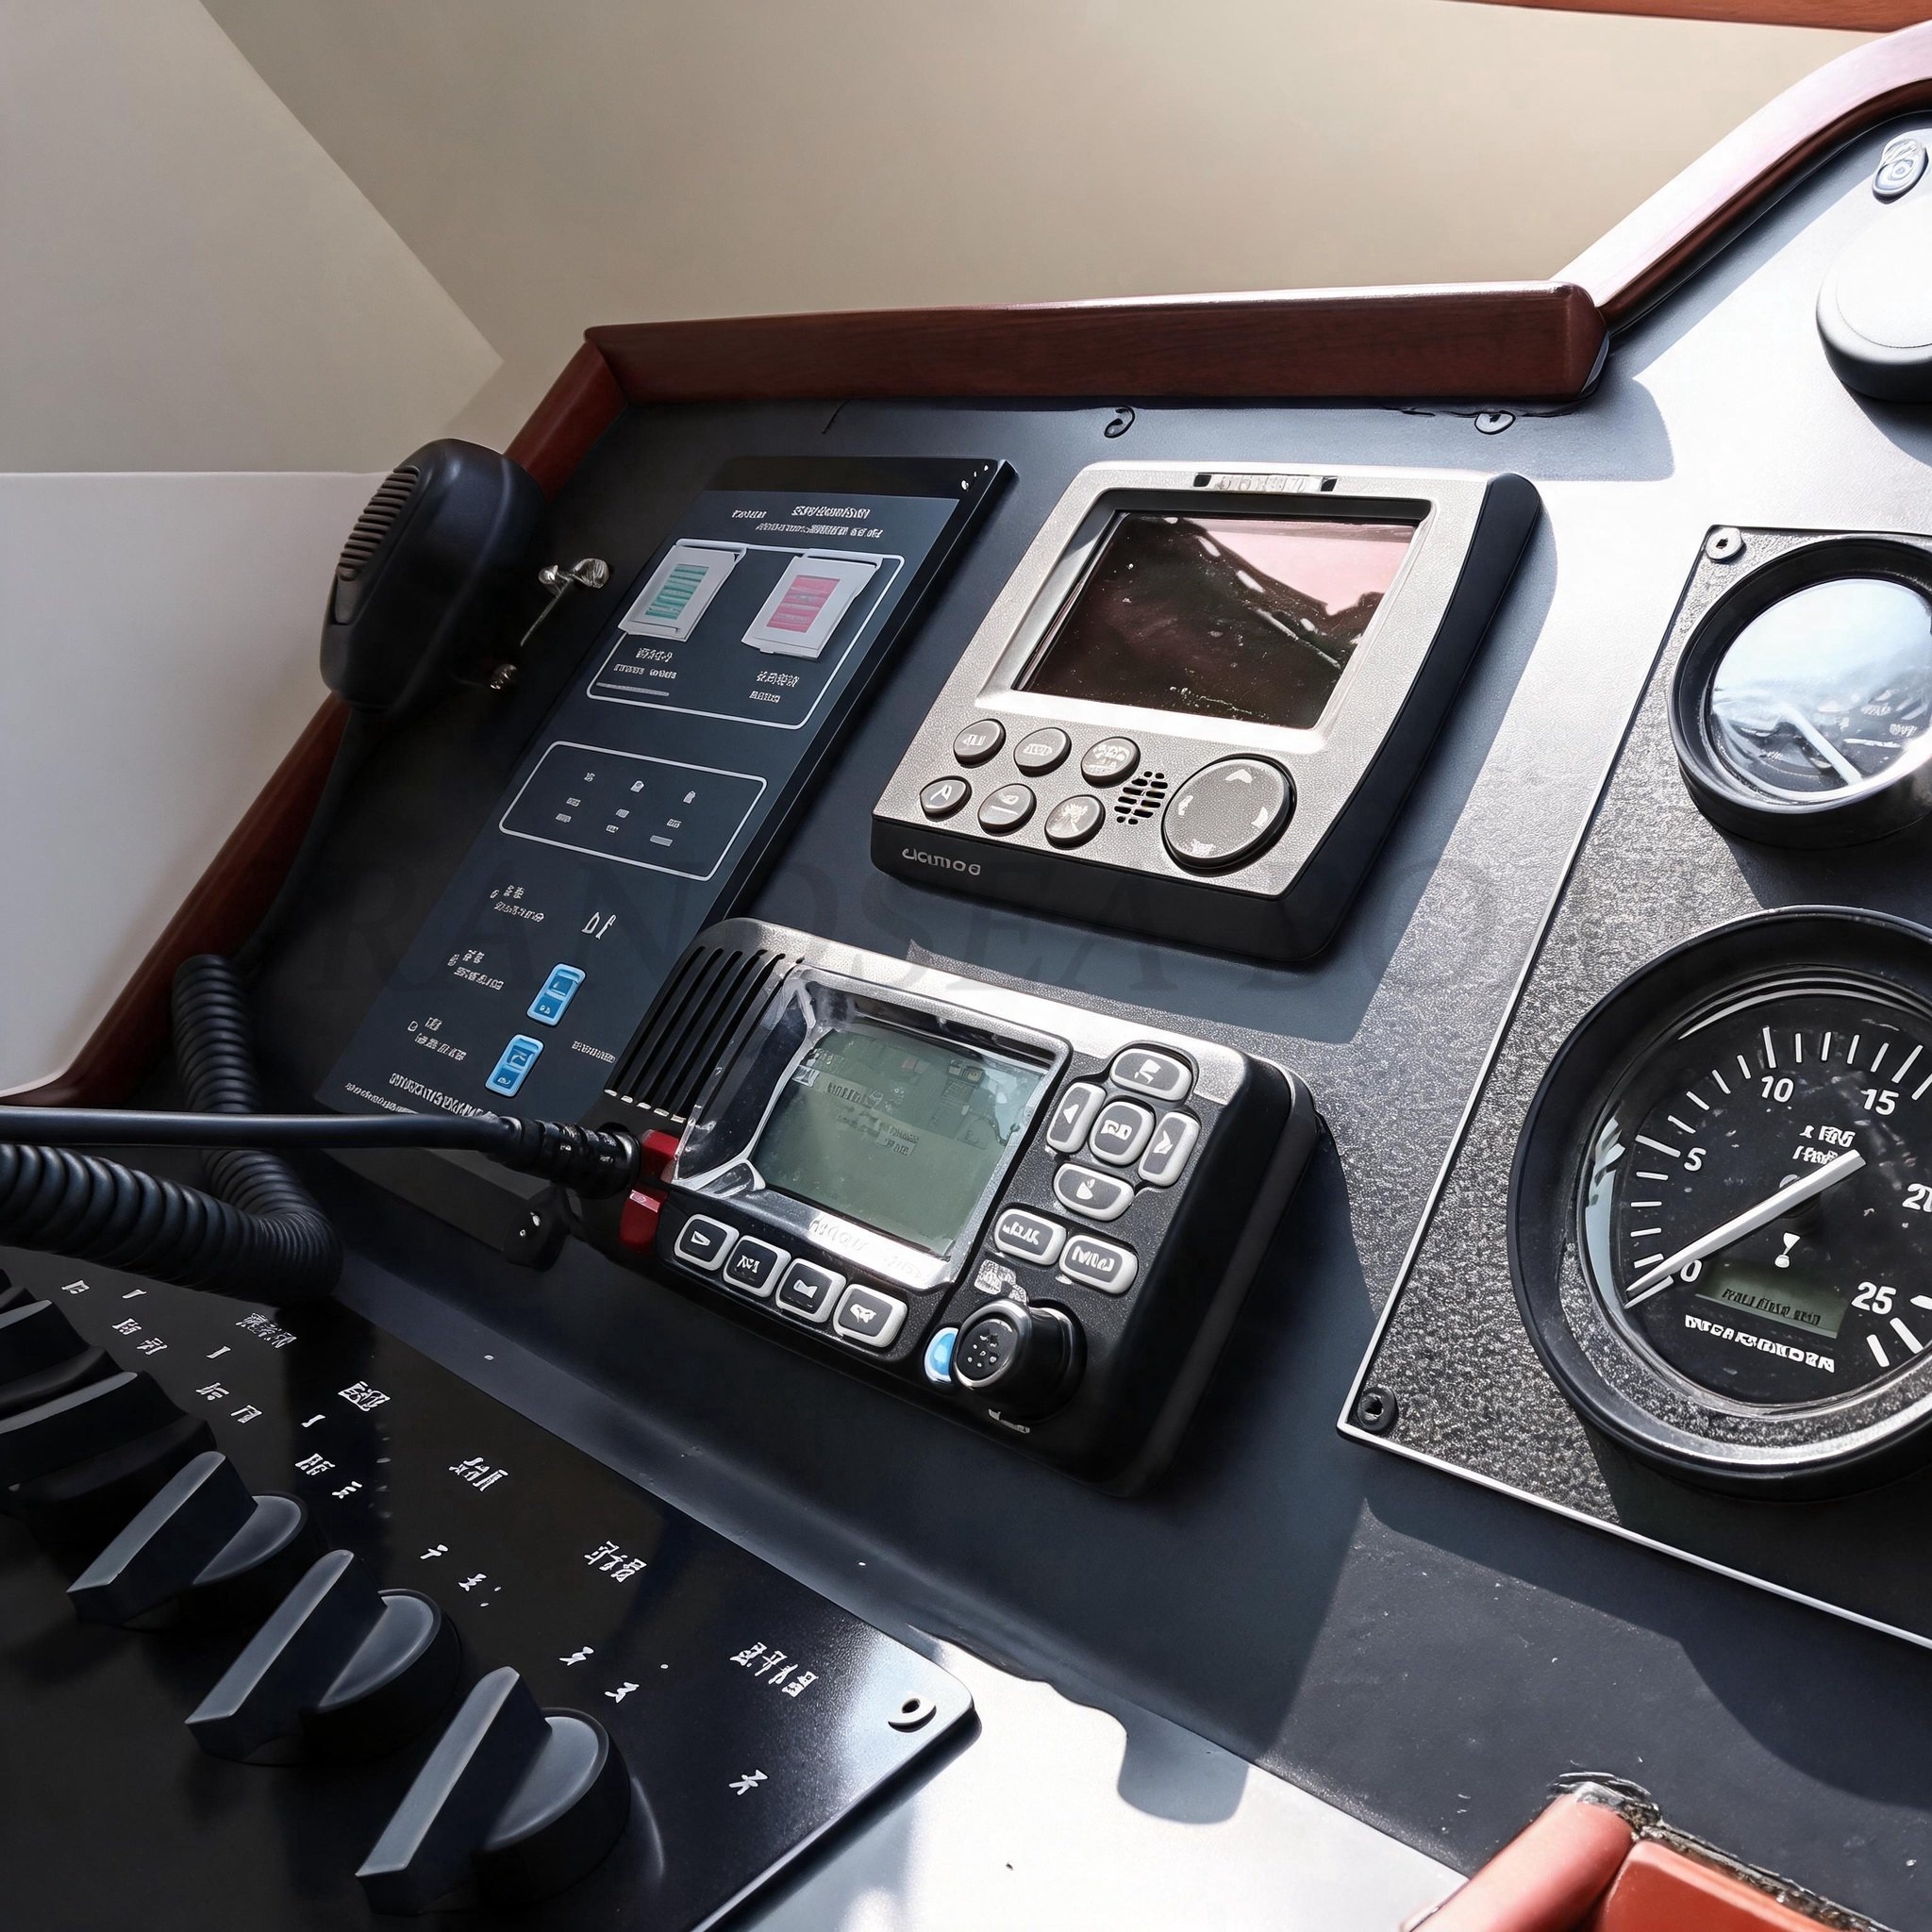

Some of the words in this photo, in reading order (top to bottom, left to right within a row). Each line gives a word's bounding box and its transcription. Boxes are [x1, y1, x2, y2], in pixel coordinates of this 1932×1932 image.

[1761, 1075, 1794, 1103] 10
[1860, 1089, 1899, 1116] 15
[1684, 1147, 1707, 1172] 5
[1680, 1259, 1703, 1283] 0
[1851, 1281, 1897, 1315] 25
